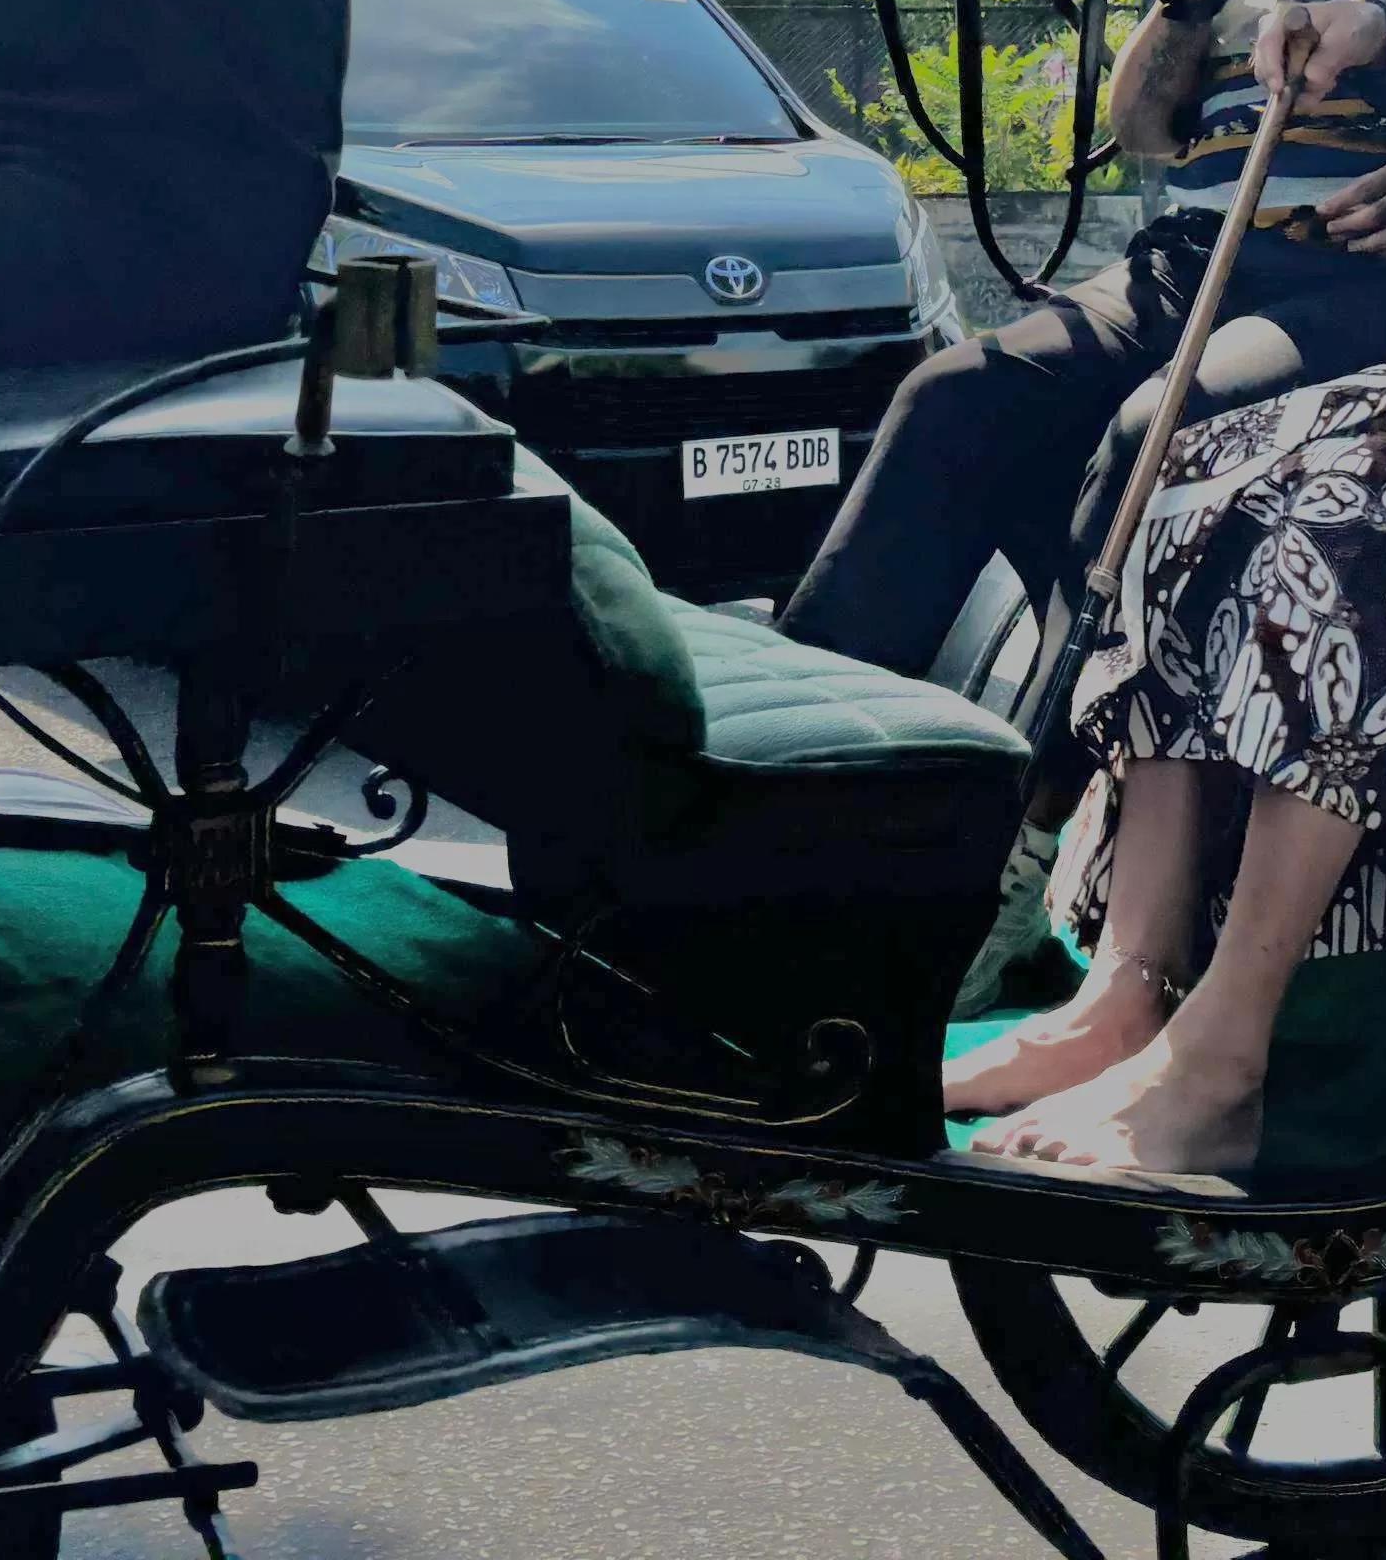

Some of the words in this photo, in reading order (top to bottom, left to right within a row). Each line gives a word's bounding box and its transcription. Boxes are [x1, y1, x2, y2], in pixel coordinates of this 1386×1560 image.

[693, 447, 707, 478] B
[717, 441, 777, 475] 7574
[787, 437, 830, 470] BDB
